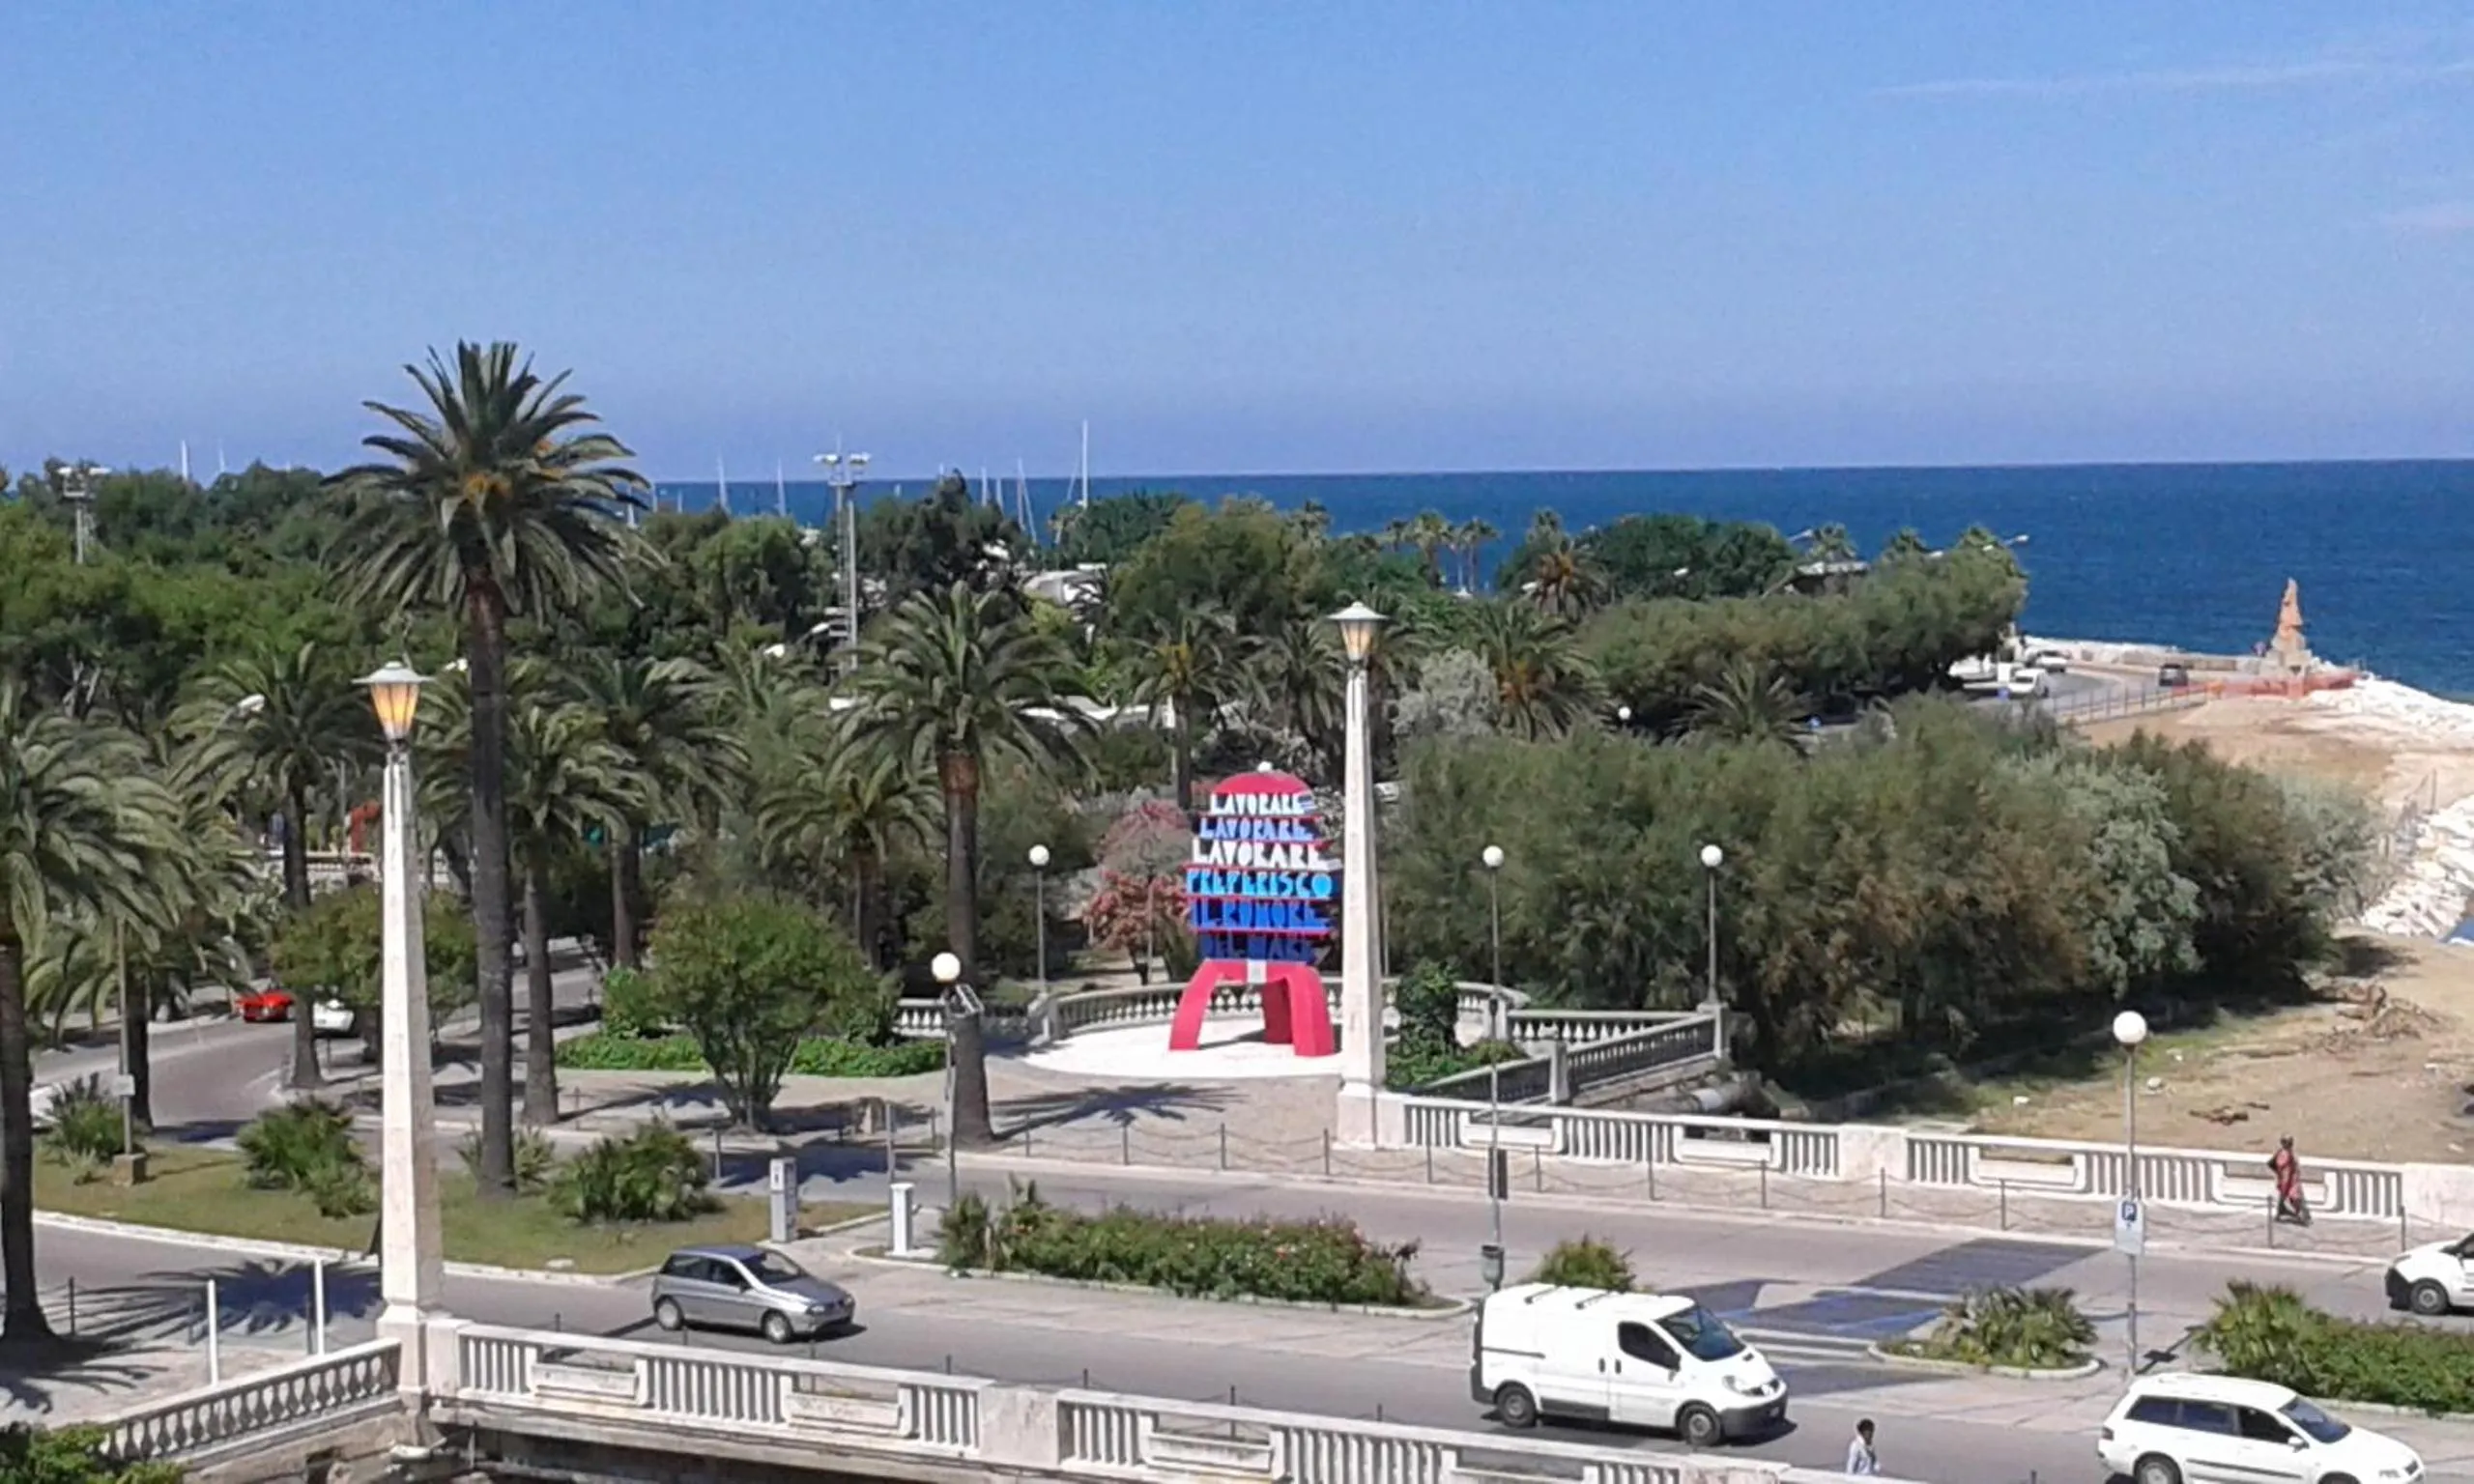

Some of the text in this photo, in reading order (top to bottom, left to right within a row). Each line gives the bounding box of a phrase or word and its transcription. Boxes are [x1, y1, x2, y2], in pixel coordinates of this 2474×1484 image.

[1210, 792, 1315, 815] LAVORARE
[1199, 816, 1314, 842] LAVORARE
[1192, 837, 1335, 870] LAVORARE
[1186, 870, 1333, 899] PREFERISCO
